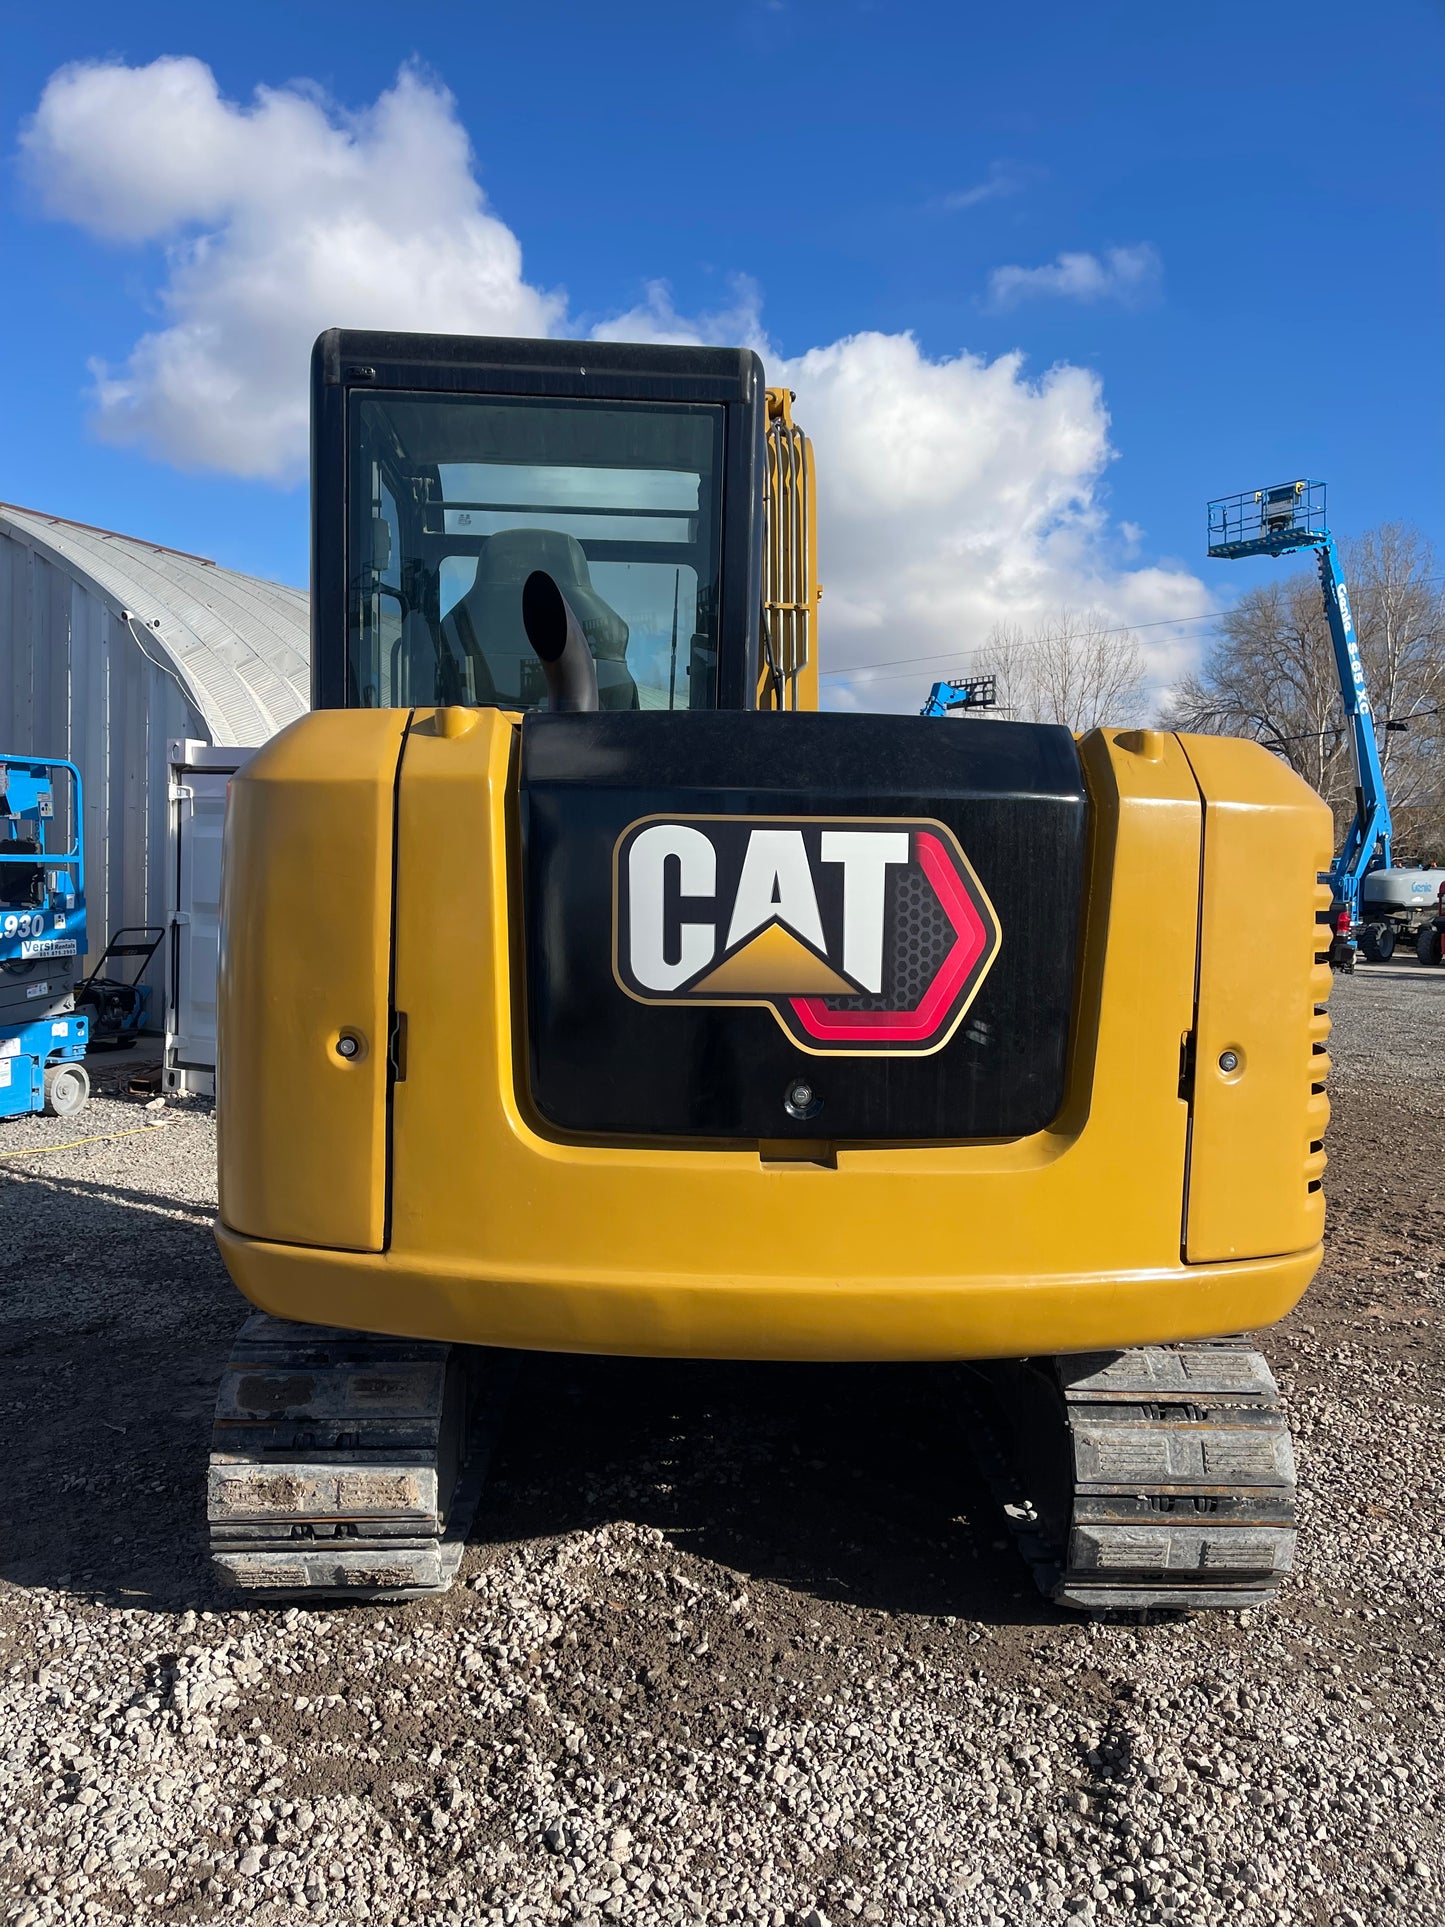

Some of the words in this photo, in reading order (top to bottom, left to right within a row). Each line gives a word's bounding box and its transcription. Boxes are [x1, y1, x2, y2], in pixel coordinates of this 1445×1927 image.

[1337, 583, 1352, 632] Genie
[1356, 688, 1370, 715] XC
[629, 824, 909, 993] CAT
[1411, 881, 1432, 893] Genie
[54, 943, 76, 951] Rentals
